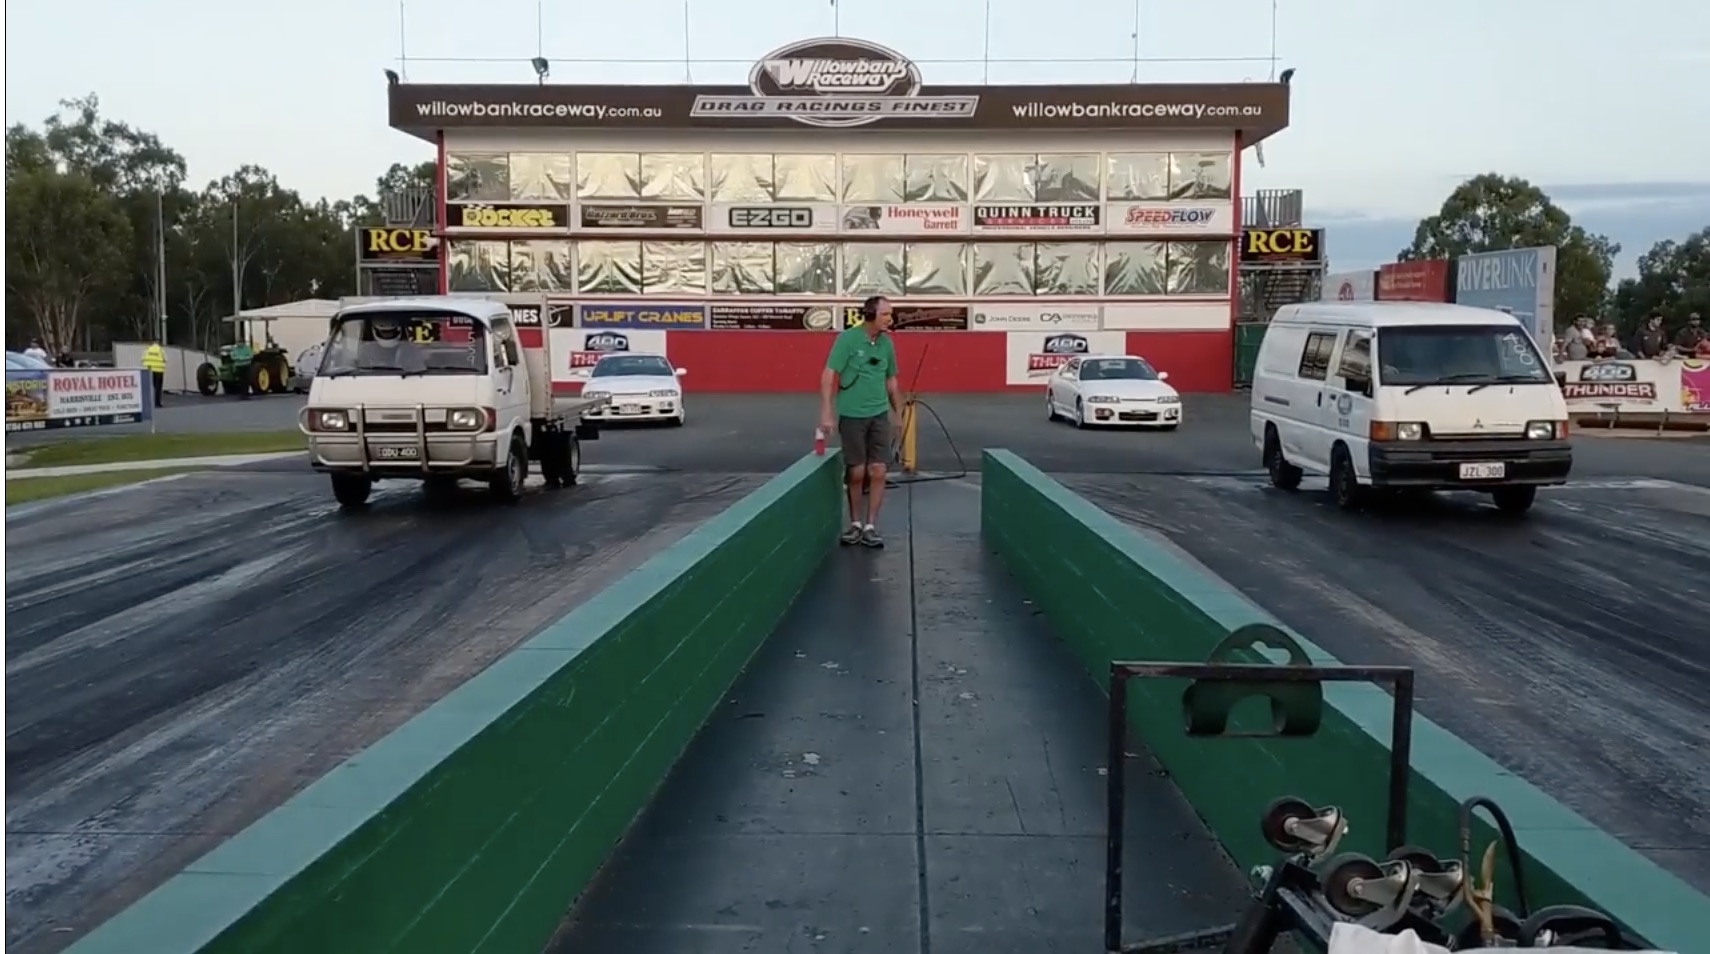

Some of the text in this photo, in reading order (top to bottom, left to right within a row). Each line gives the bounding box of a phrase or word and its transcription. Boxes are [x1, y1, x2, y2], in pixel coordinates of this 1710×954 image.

[768, 58, 908, 86] Willowbank
[807, 71, 900, 89] Raceway
[416, 101, 662, 119] willowbankraceway.com.au
[700, 101, 969, 112] DRAG RACINGS FINEST
[1012, 102, 1262, 118] willowbankraceway.com.au
[888, 206, 959, 219] Honeywell
[977, 207, 1095, 218] QUINN TRUCK
[923, 219, 958, 230] Garrett
[369, 229, 432, 252] RCE
[1248, 230, 1314, 253] RCE
[1459, 254, 1536, 291] RIVERLINK
[513, 309, 539, 323] NES
[583, 311, 635, 323] UPLIFT
[638, 311, 704, 323] CRANES
[573, 354, 599, 366] THU
[53, 375, 139, 392] ROYAL HOTEL
[1564, 384, 1653, 397] THUNDER
